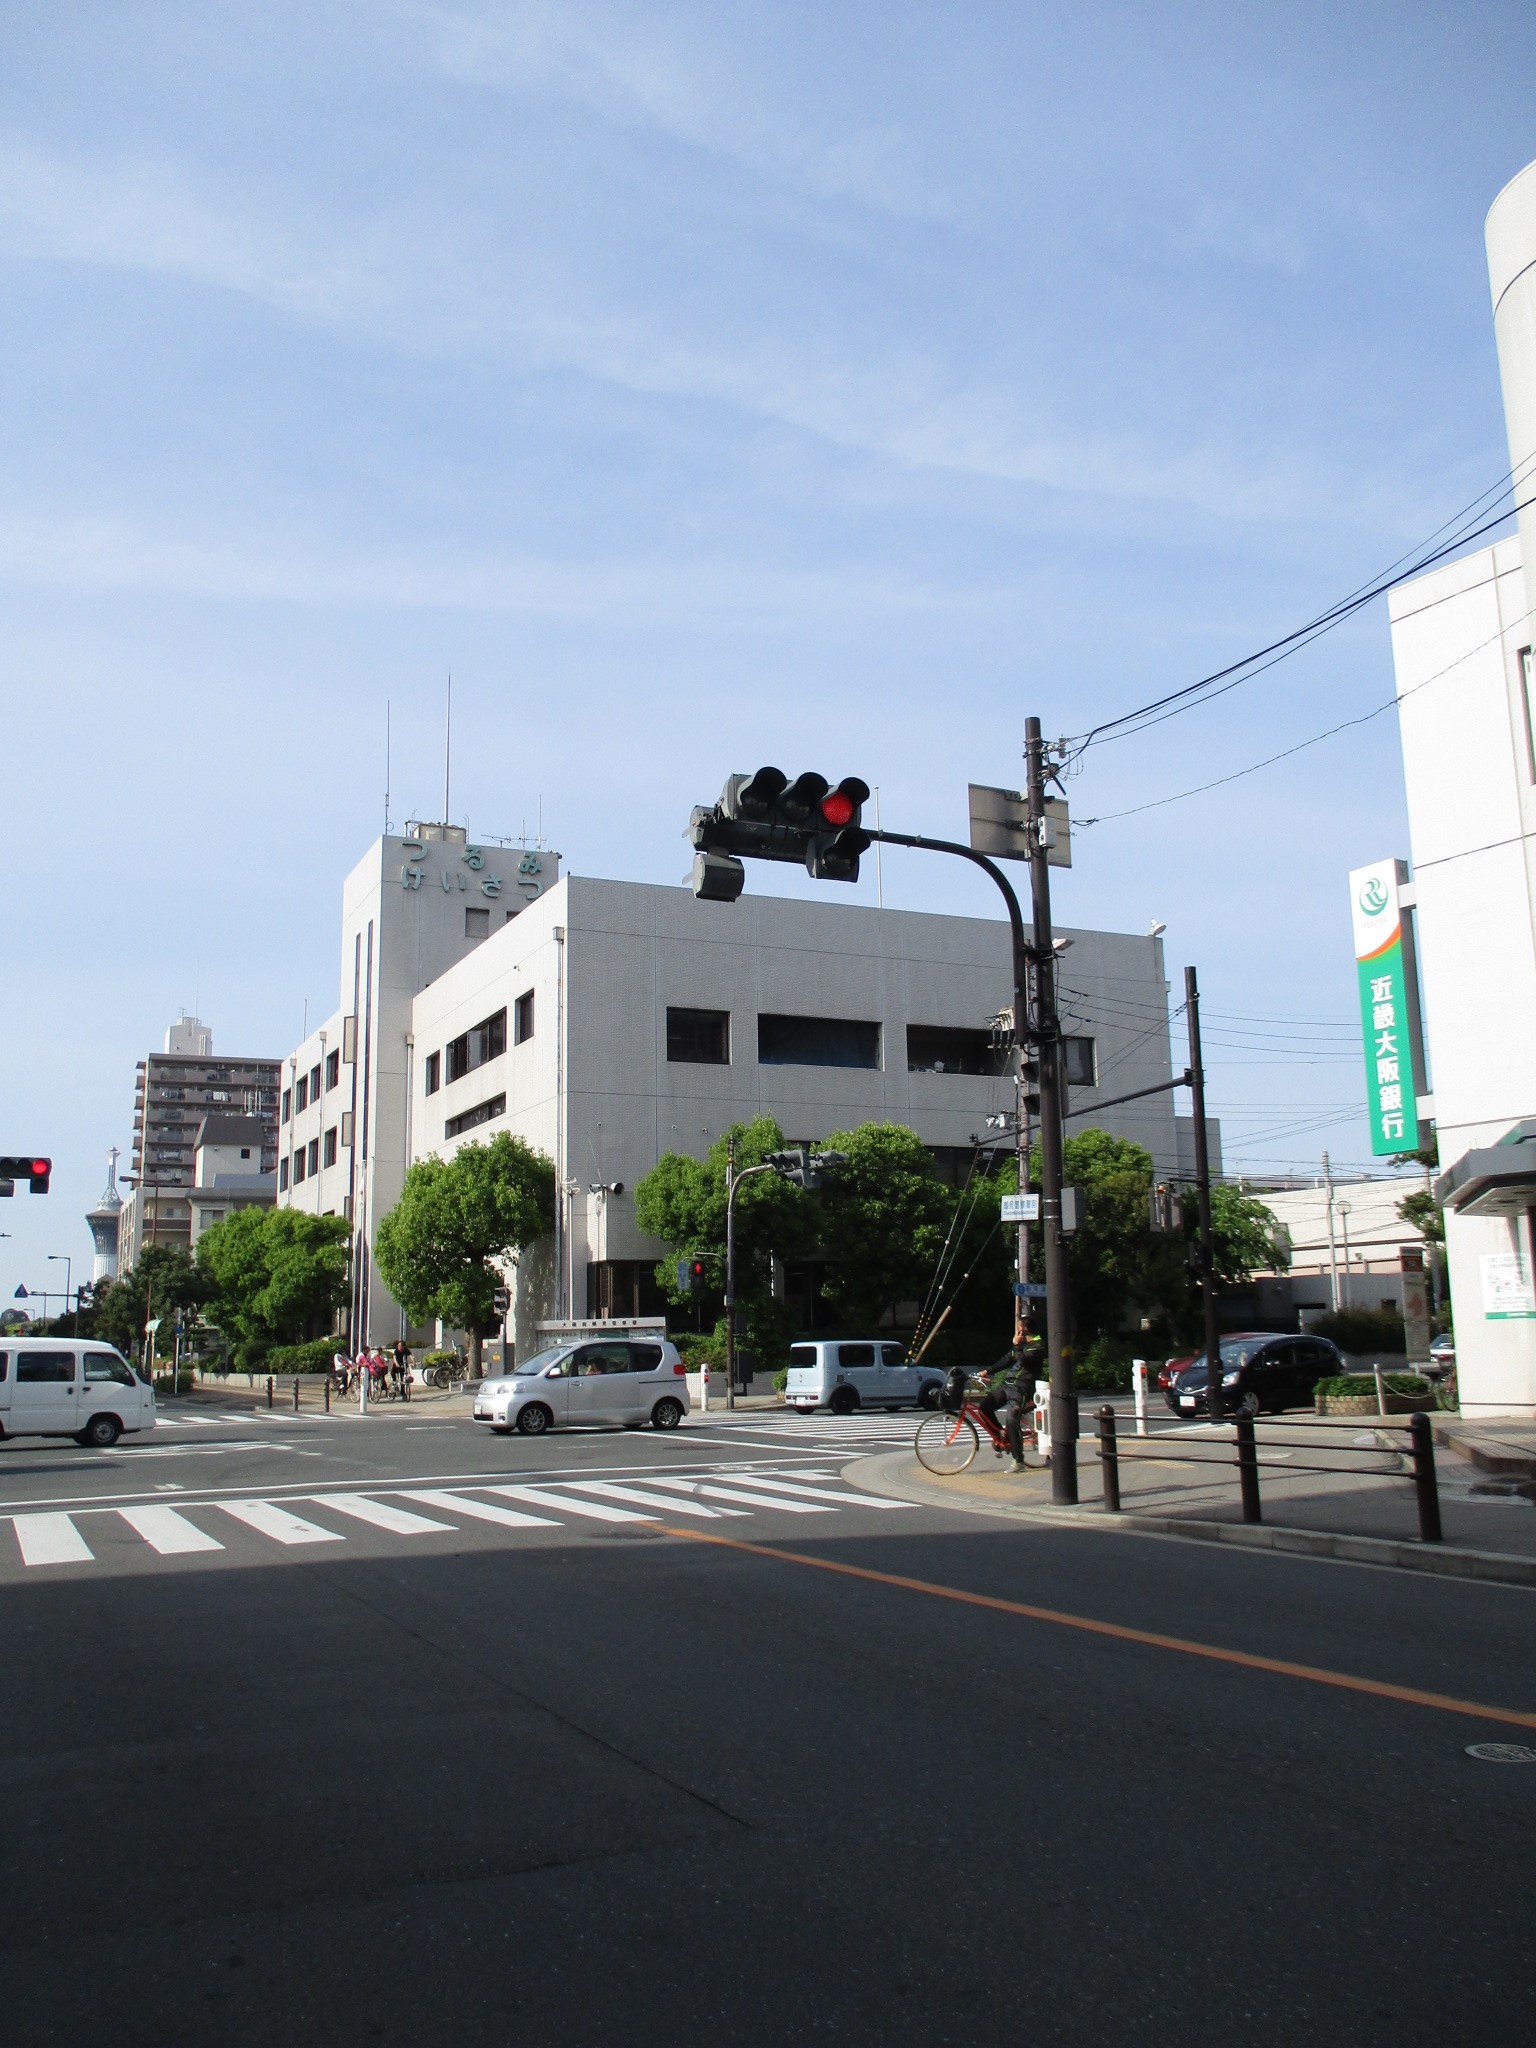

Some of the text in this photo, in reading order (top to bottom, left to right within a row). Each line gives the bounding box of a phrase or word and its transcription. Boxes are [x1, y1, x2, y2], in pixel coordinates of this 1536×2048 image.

[402, 842, 542, 875] つるみ
[401, 864, 544, 900] けいさつ
[1370, 974, 1404, 1140] 近畿大阪銀行
